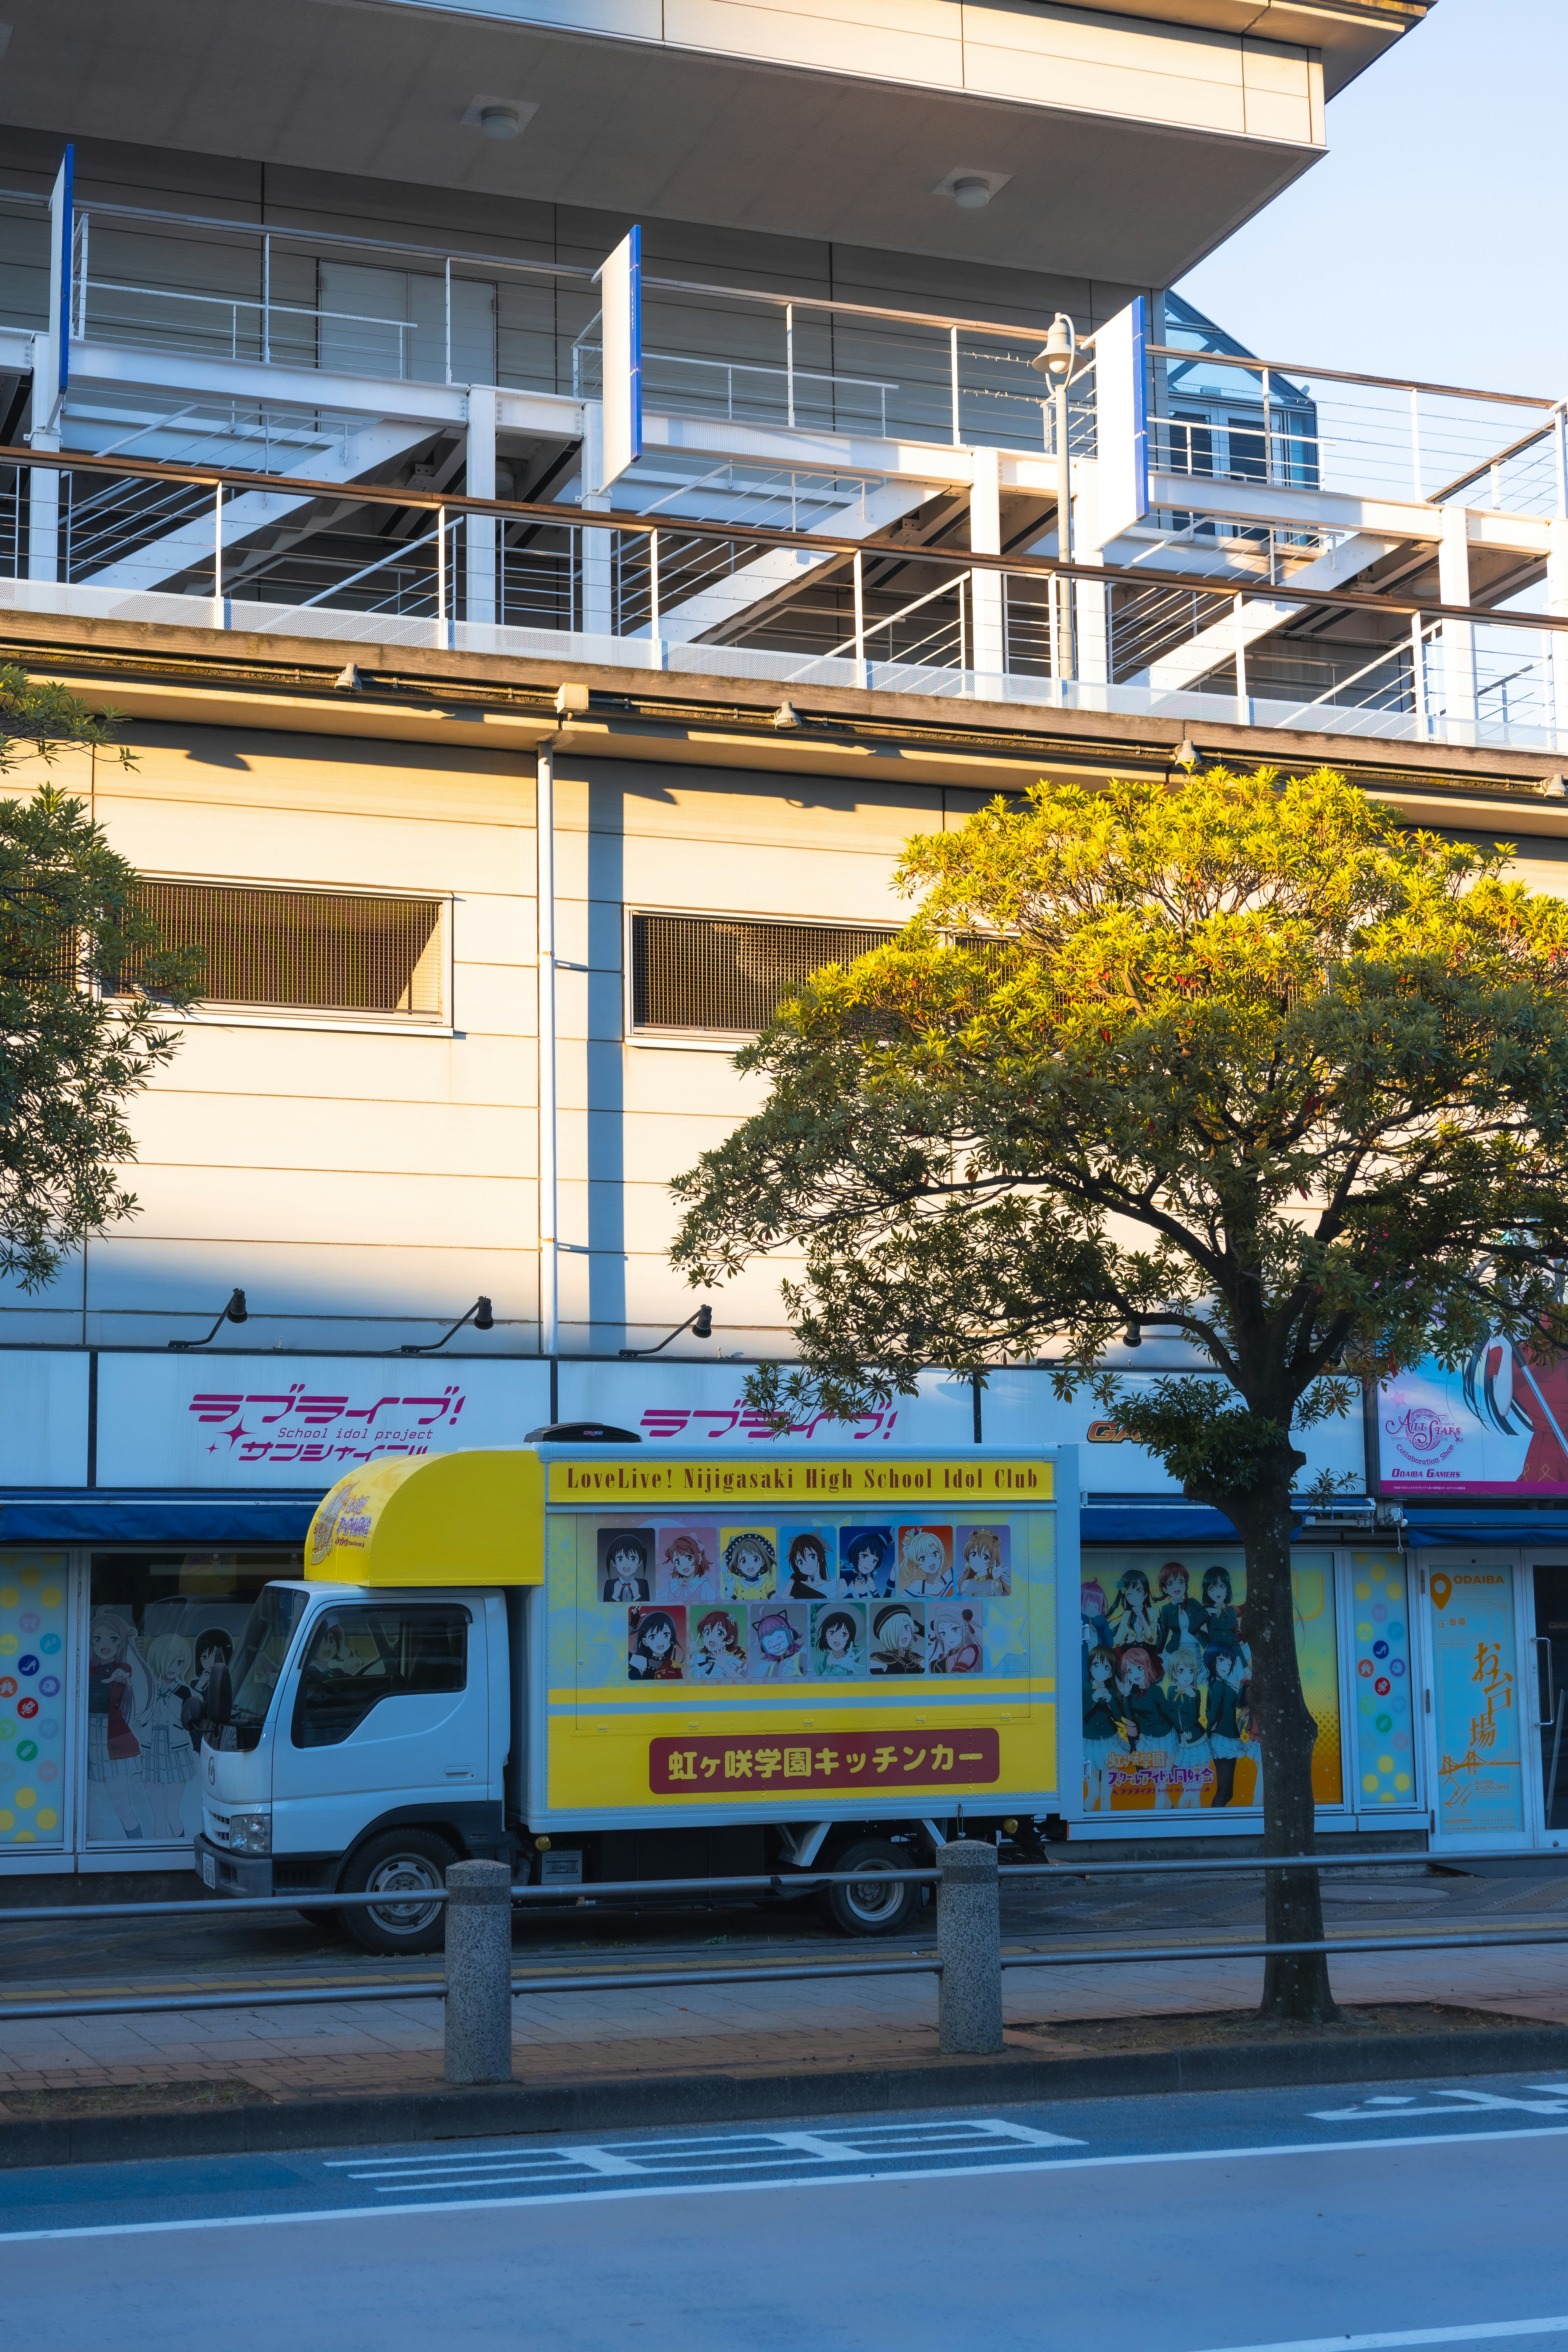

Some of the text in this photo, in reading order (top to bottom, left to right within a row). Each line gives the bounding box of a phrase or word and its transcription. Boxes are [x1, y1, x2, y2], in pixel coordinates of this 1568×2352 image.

[278, 1427, 433, 1441] School idol project
[1396, 1444, 1454, 1465] Collaboration Shop
[567, 1468, 1037, 1494] LoveLive! Nijigasaki High School Idol Club
[1391, 1468, 1461, 1478] ODAIBA GAMERS
[1453, 1575, 1505, 1584] ODAIBA
[1107, 1767, 1215, 1787] スクールアイドル同好会
